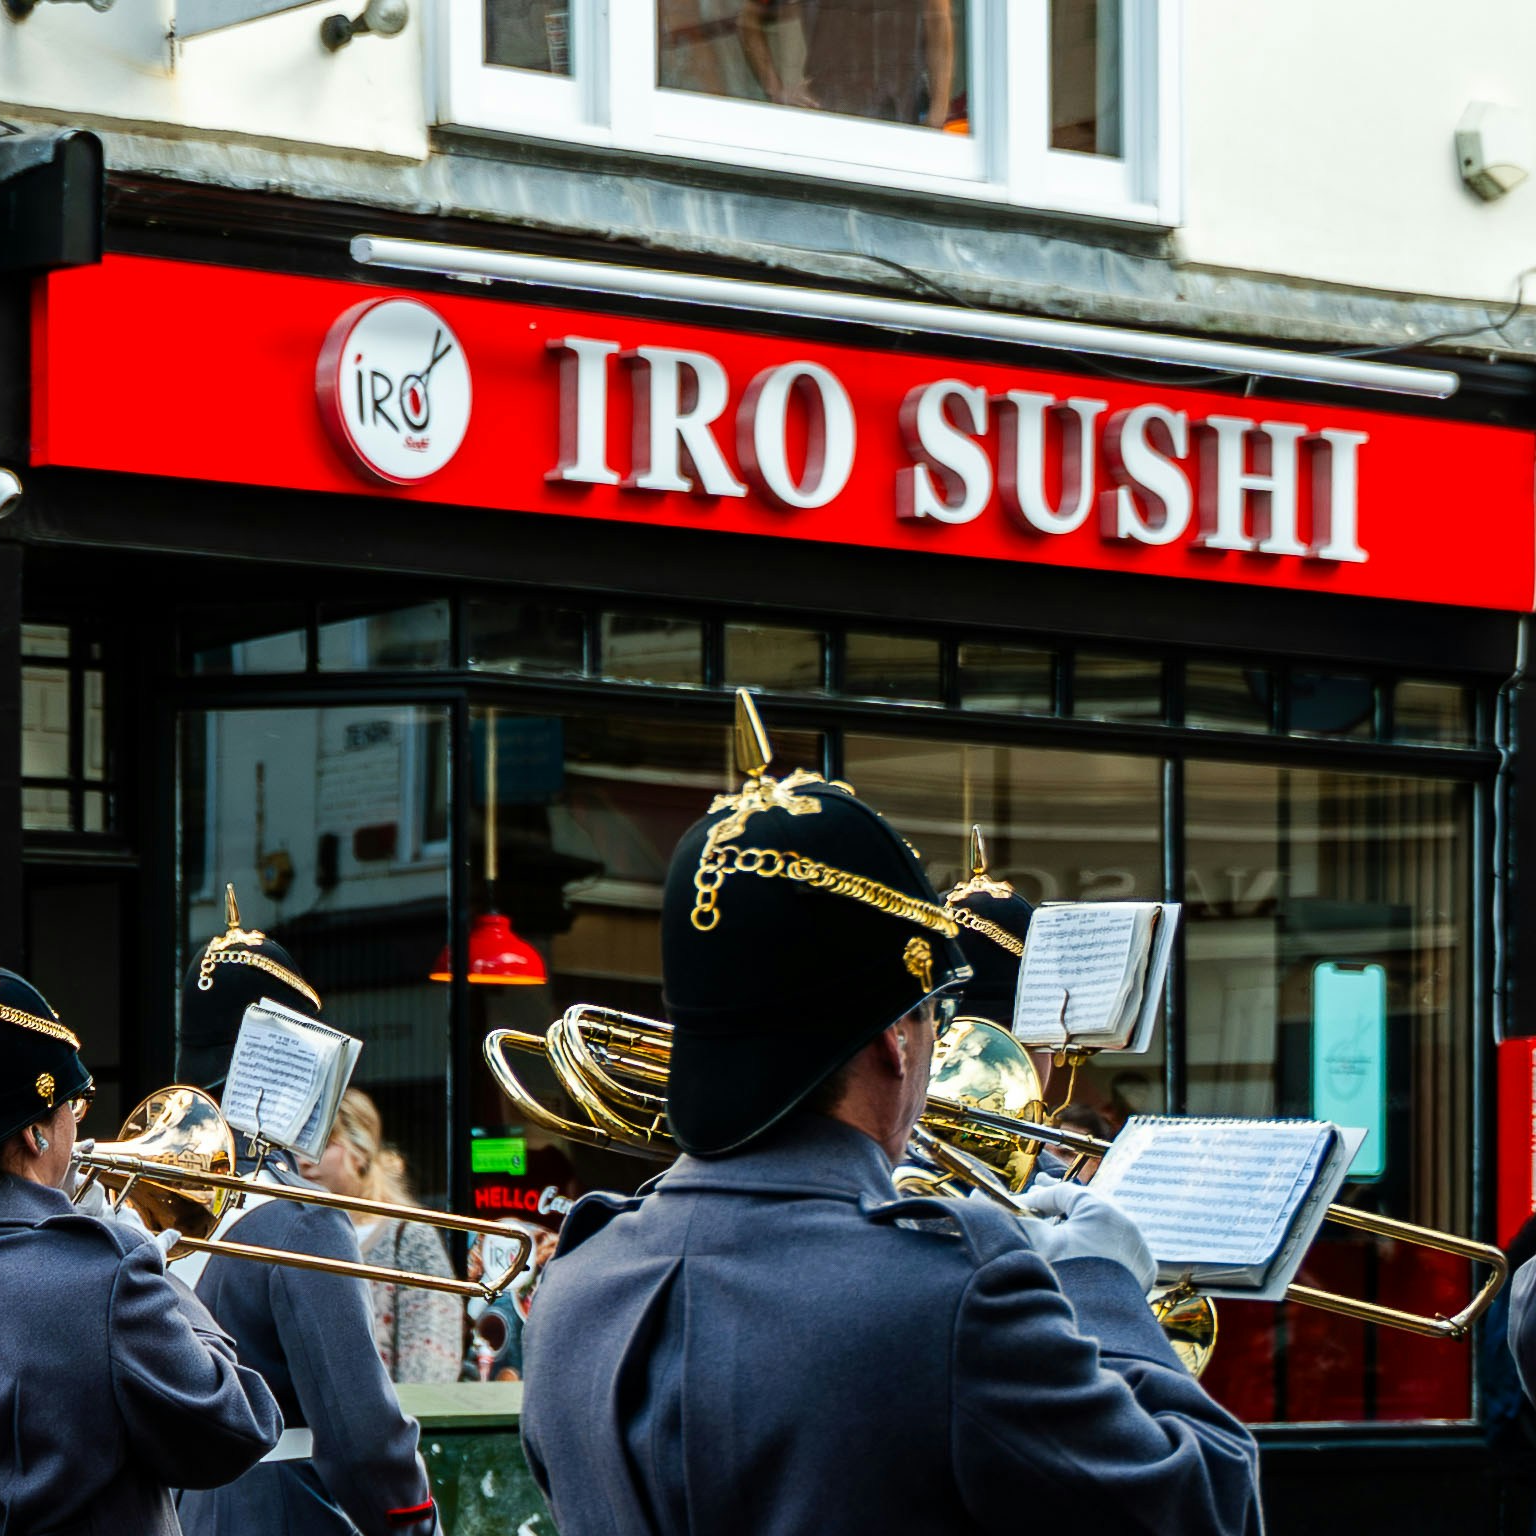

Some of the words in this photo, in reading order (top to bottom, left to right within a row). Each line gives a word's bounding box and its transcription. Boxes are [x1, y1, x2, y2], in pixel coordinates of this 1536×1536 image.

[545, 334, 857, 510] IRO
[897, 377, 1370, 566] SUSHI
[475, 1186, 539, 1212] HELLO
